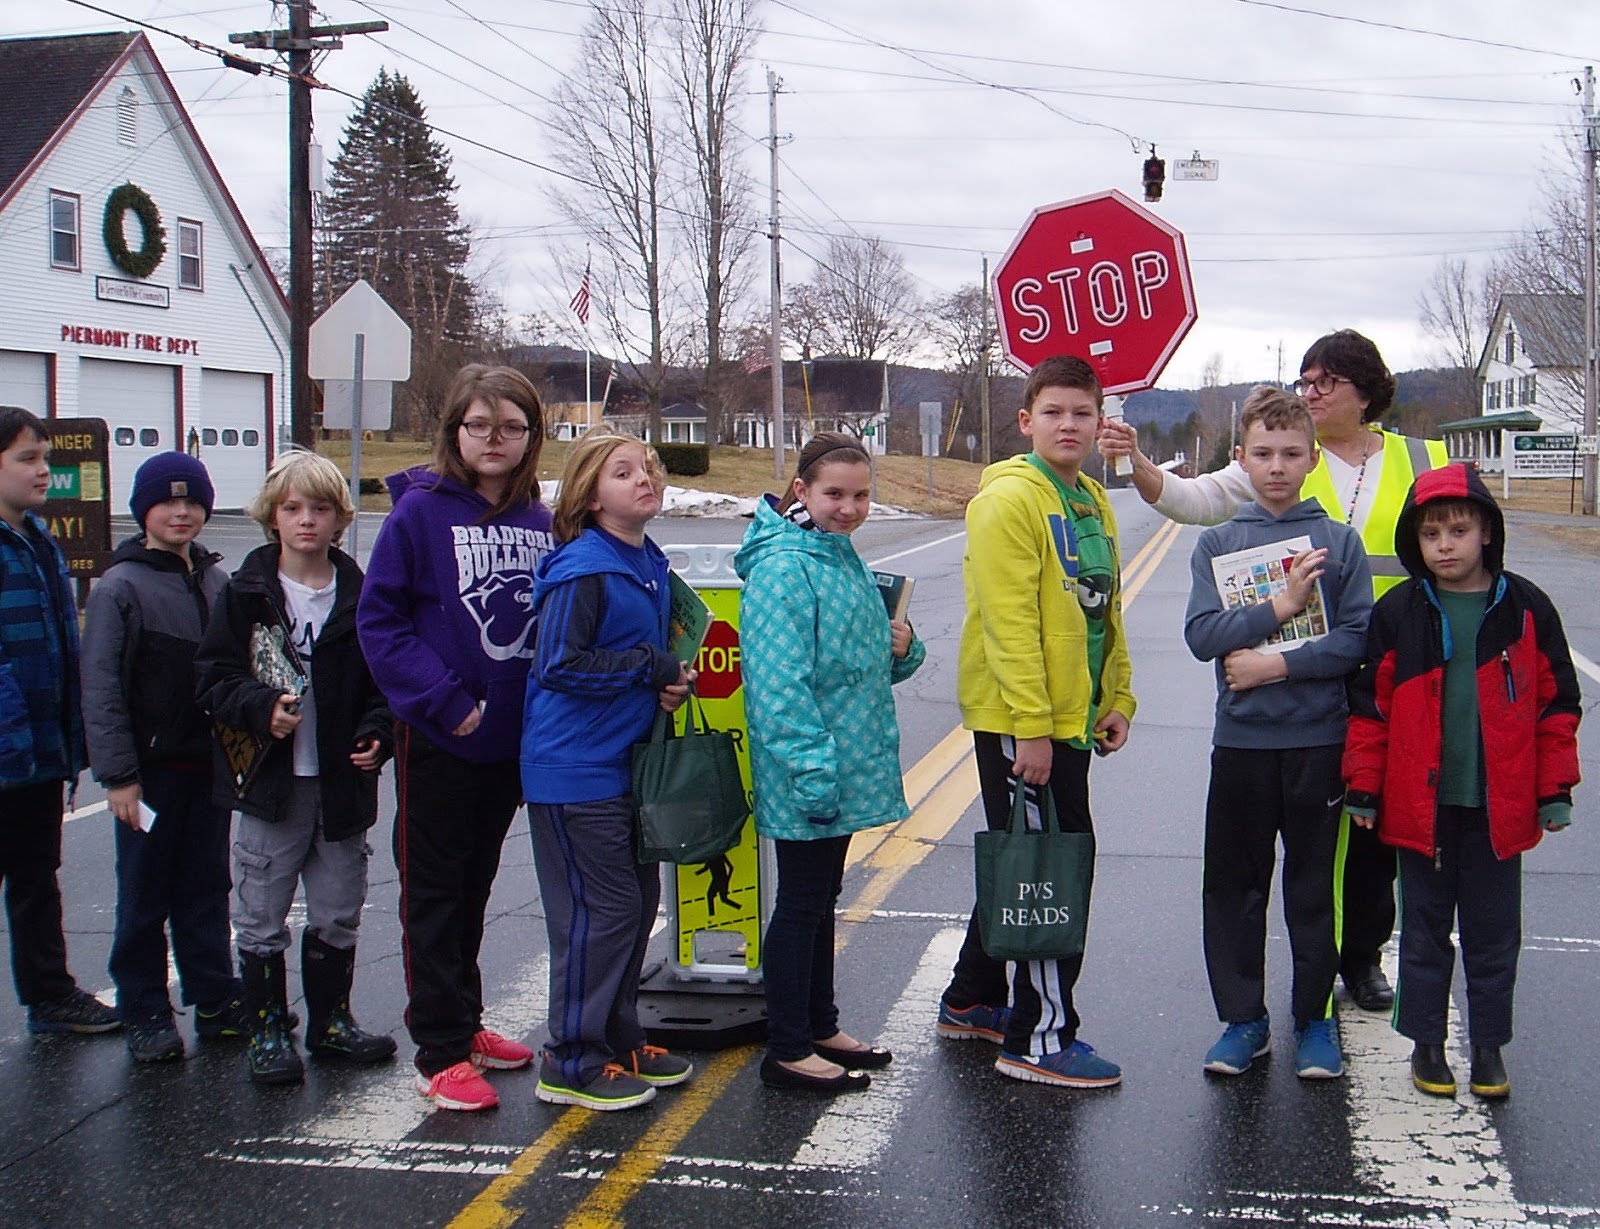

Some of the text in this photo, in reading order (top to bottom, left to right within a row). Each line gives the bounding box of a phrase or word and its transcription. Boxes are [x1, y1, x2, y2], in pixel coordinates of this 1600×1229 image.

[1011, 250, 1169, 344] STOP
[61, 324, 130, 348] PIERMONT
[135, 333, 162, 352] FIRE
[454, 544, 550, 594] BULLDO
[698, 647, 742, 673] TOP
[1017, 882, 1054, 901] PVS
[1001, 906, 1070, 926] READS
